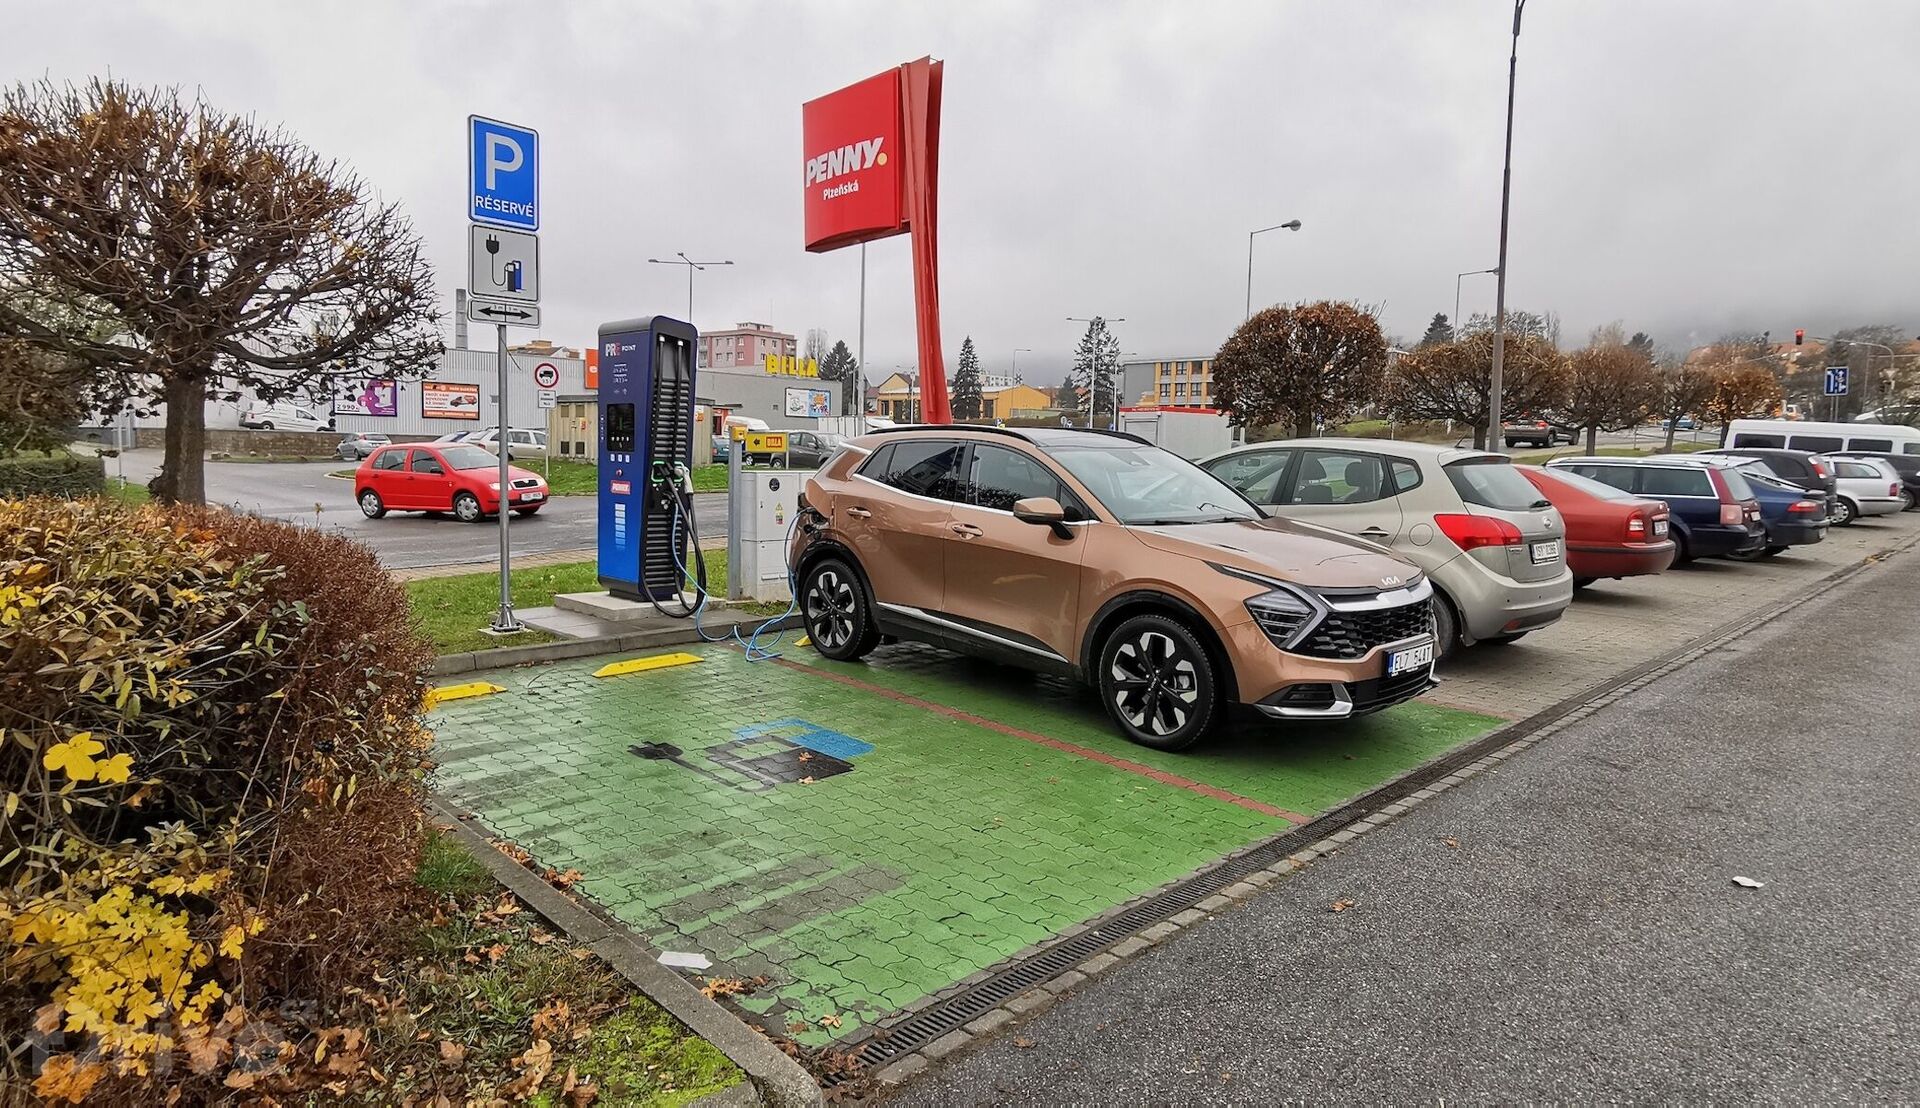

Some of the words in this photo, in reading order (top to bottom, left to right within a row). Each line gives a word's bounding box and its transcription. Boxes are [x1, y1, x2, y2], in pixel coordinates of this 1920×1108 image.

[485, 131, 524, 191] P
[823, 180, 859, 201] Plzeňská
[474, 194, 534, 218] RÉSERVÉ
[621, 344, 636, 352] POINT
[764, 354, 818, 378] BILLA
[1381, 575, 1401, 586] KIA
[1394, 652, 1409, 671] EL7
[1413, 646, 1431, 665] 54AT
